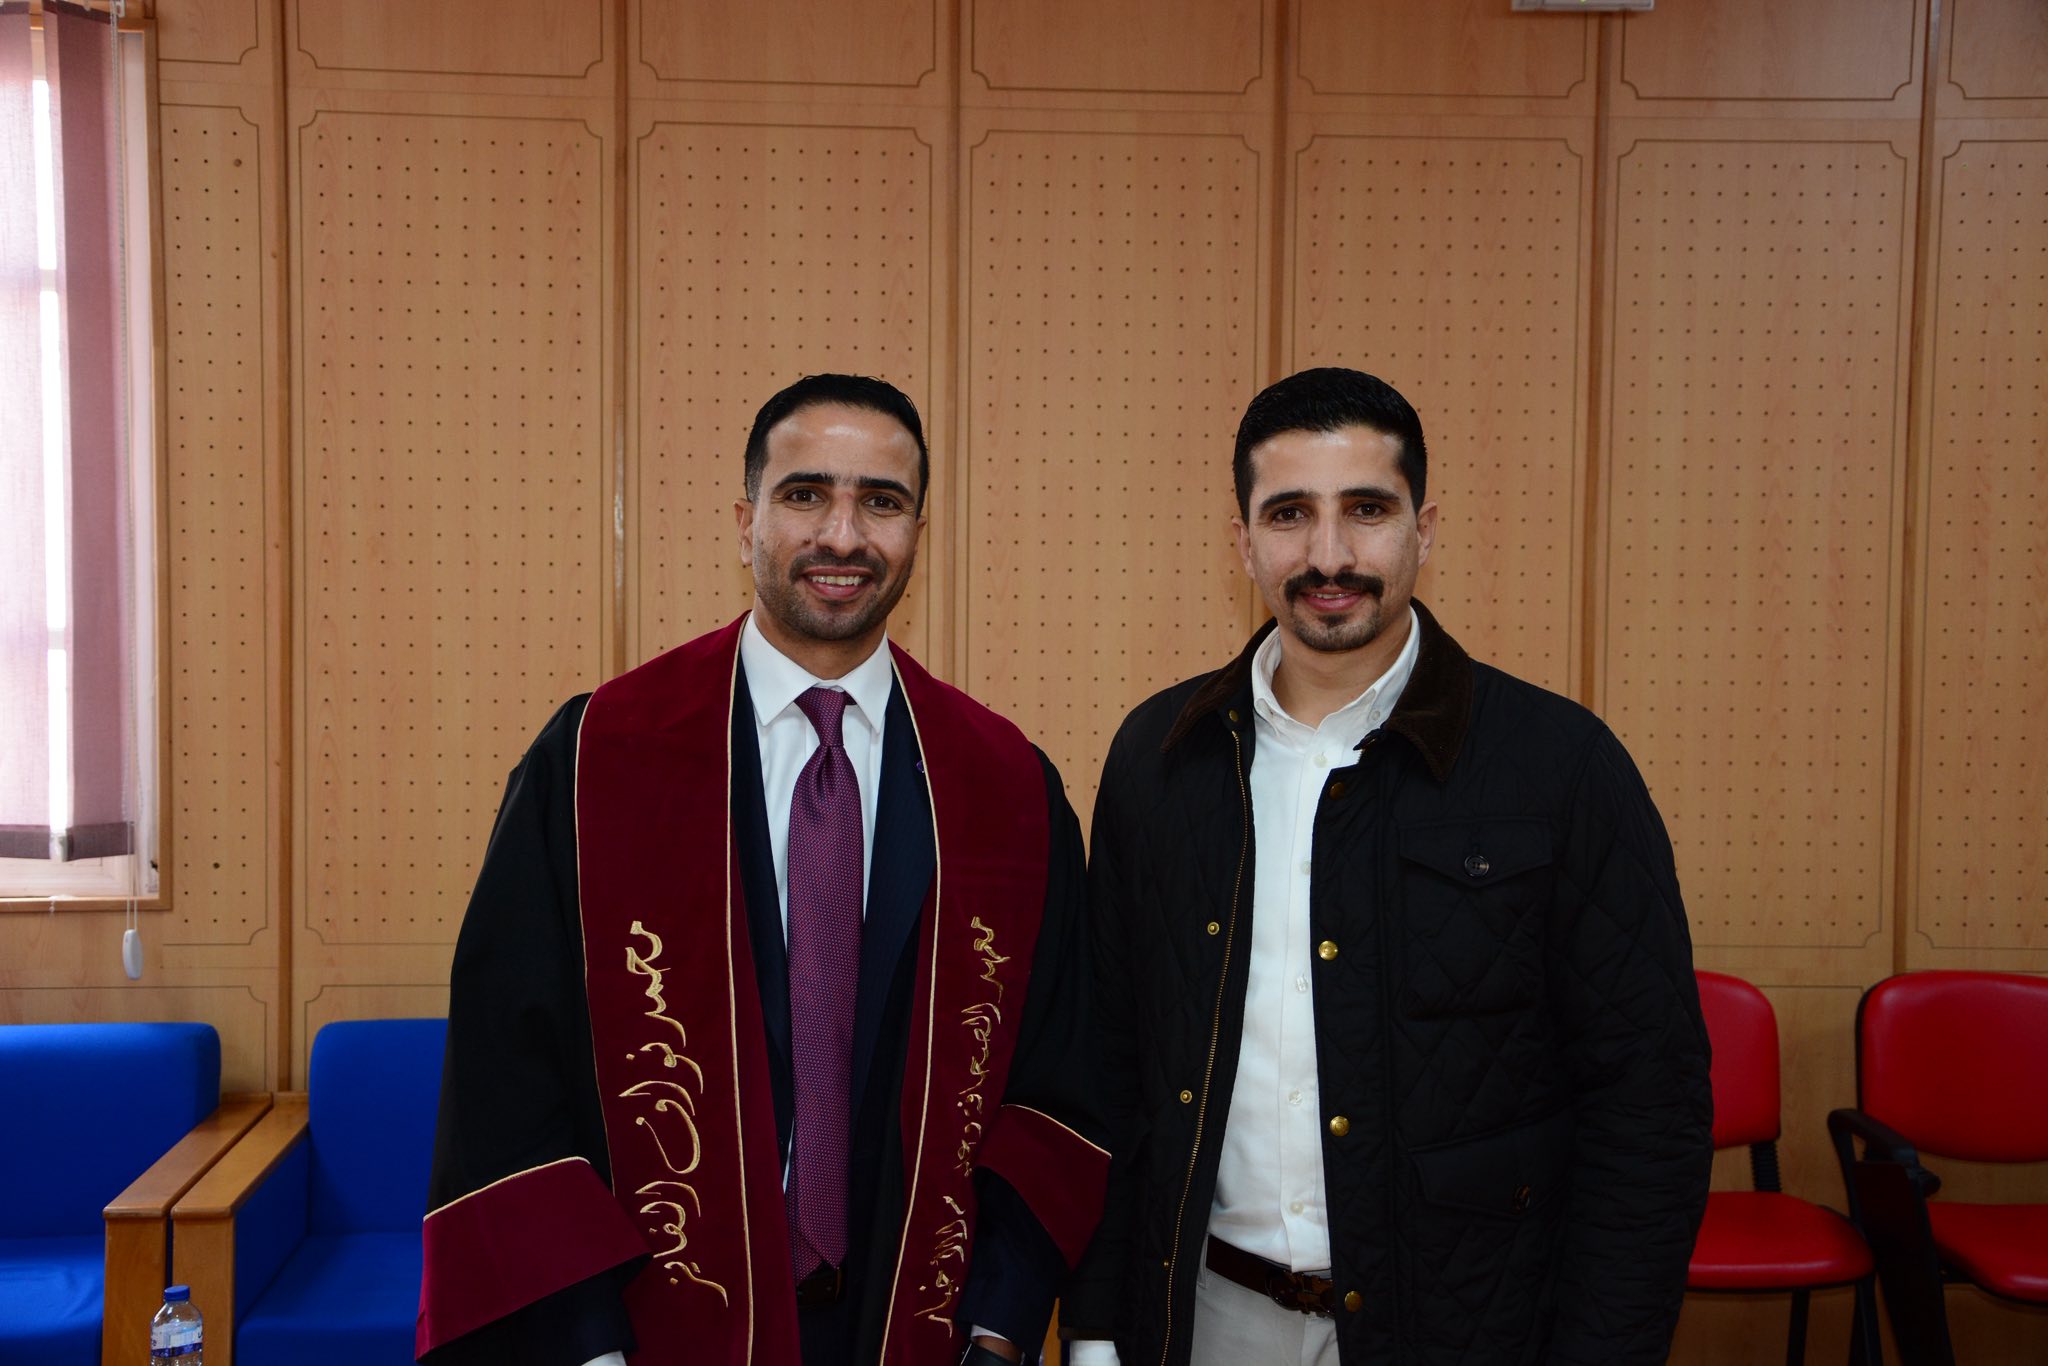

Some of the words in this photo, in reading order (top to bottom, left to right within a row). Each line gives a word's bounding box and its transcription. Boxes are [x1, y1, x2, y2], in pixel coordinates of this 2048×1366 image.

[625, 920, 687, 1048] محمد
[970, 916, 1011, 1002] معهد
[619, 1042, 704, 1174] نواف
[956, 1002, 1001, 1117] الصحافة
[635, 1180, 729, 1308] الفايز
